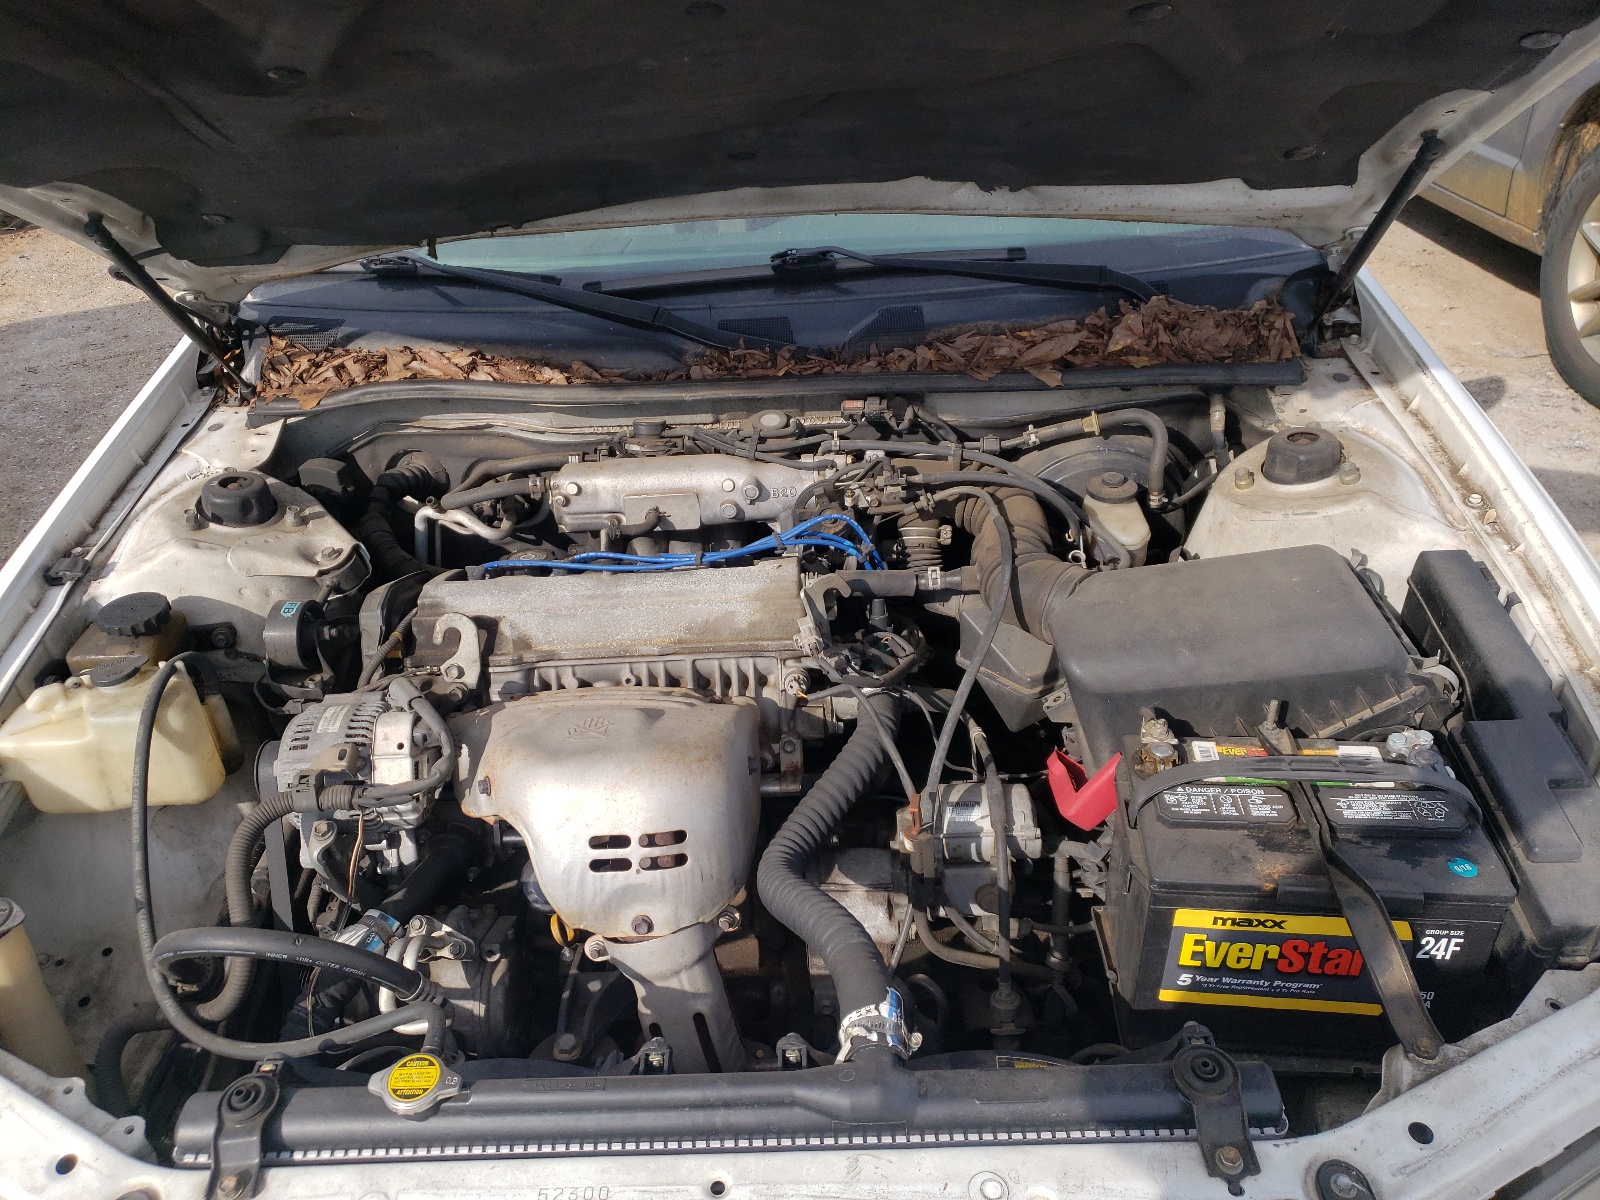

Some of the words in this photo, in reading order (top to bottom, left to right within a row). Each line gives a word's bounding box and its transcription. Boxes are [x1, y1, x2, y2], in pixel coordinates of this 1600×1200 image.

[771, 487, 798, 498] B20
[1212, 916, 1288, 930] maxx
[1416, 937, 1464, 960] 24F
[316, 960, 340, 969] OUTER
[1176, 974, 1193, 986] 5
[1195, 974, 1220, 983] Year
[1222, 976, 1271, 987] Warranty
[1421, 991, 1435, 1000] 50
[537, 1186, 609, 1200] 52300
